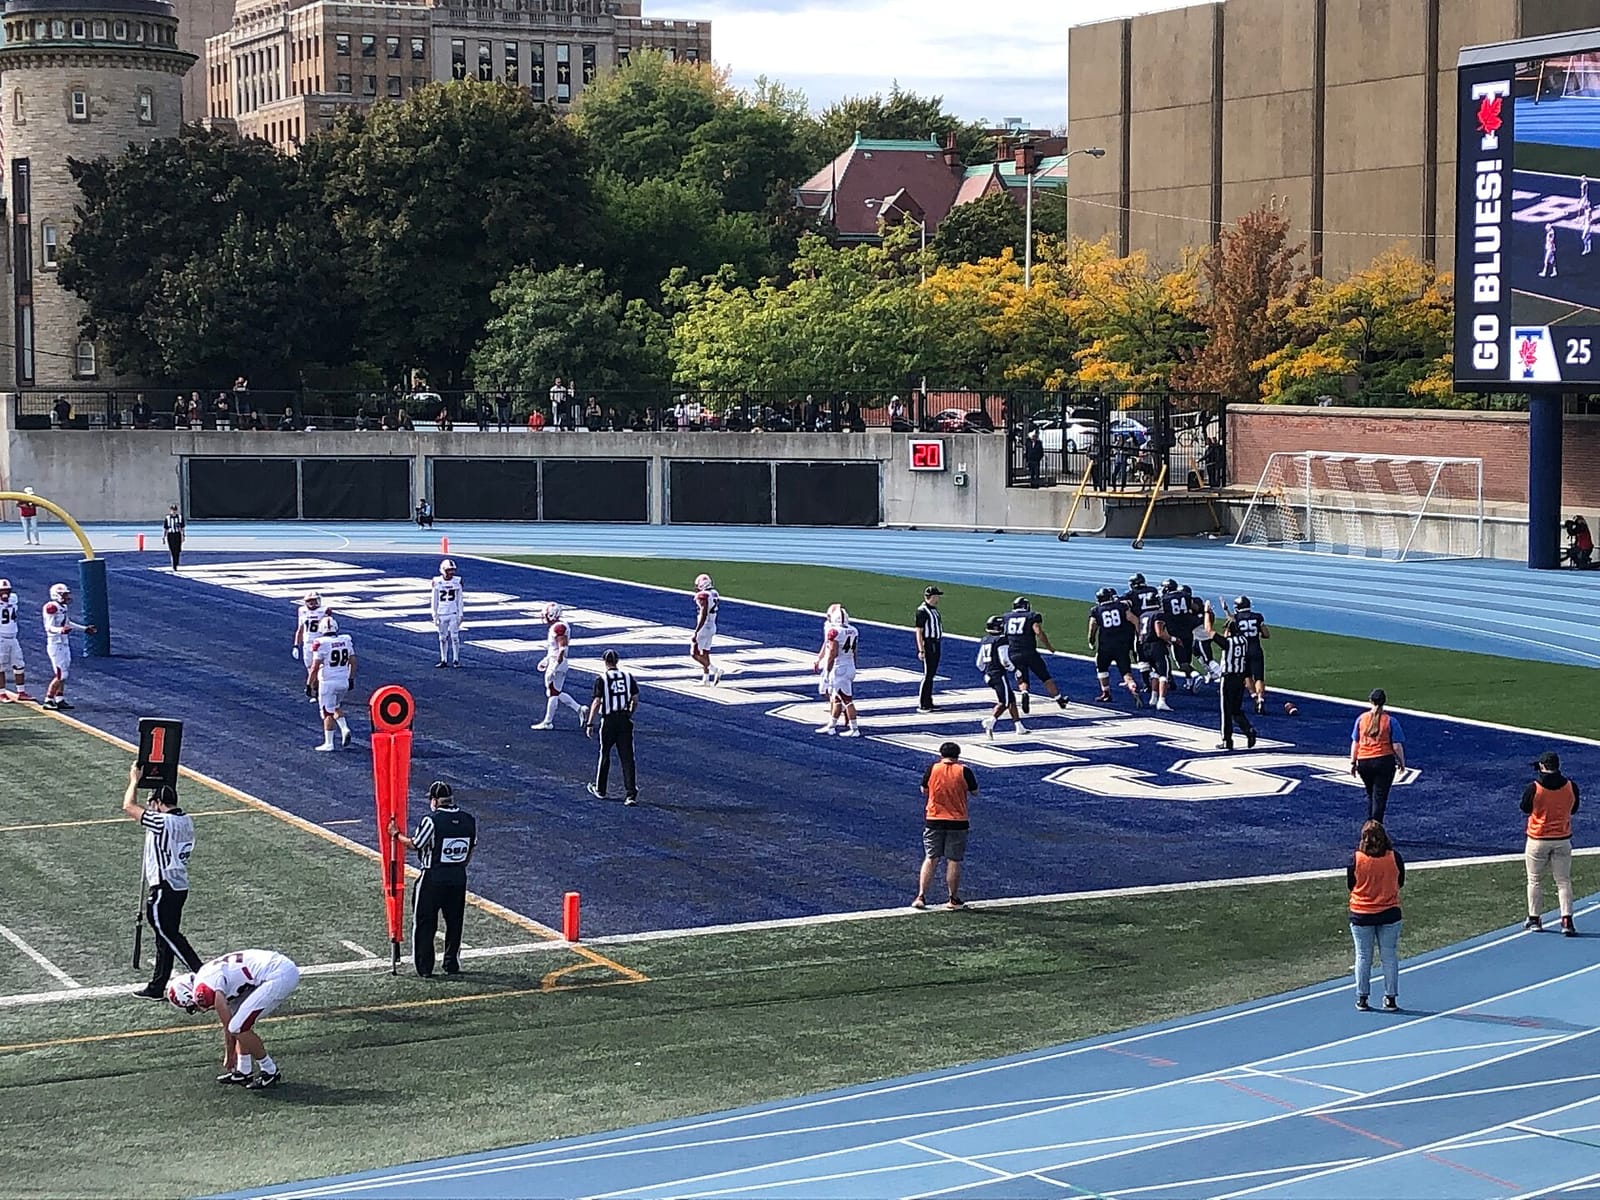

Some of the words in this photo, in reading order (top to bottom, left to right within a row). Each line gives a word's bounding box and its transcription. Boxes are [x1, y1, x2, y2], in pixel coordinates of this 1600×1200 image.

[1474, 159, 1503, 302] BLUES!
[1473, 314, 1499, 370] GO
[1565, 339, 1591, 364] 25
[914, 445, 939, 466] 20
[1171, 596, 1188, 615] 64
[1007, 616, 1026, 635] 67
[1101, 609, 1122, 628] 68
[1237, 619, 1258, 637] 25
[329, 648, 349, 667] 98
[610, 679, 626, 694] 45
[148, 726, 166, 764] 1
